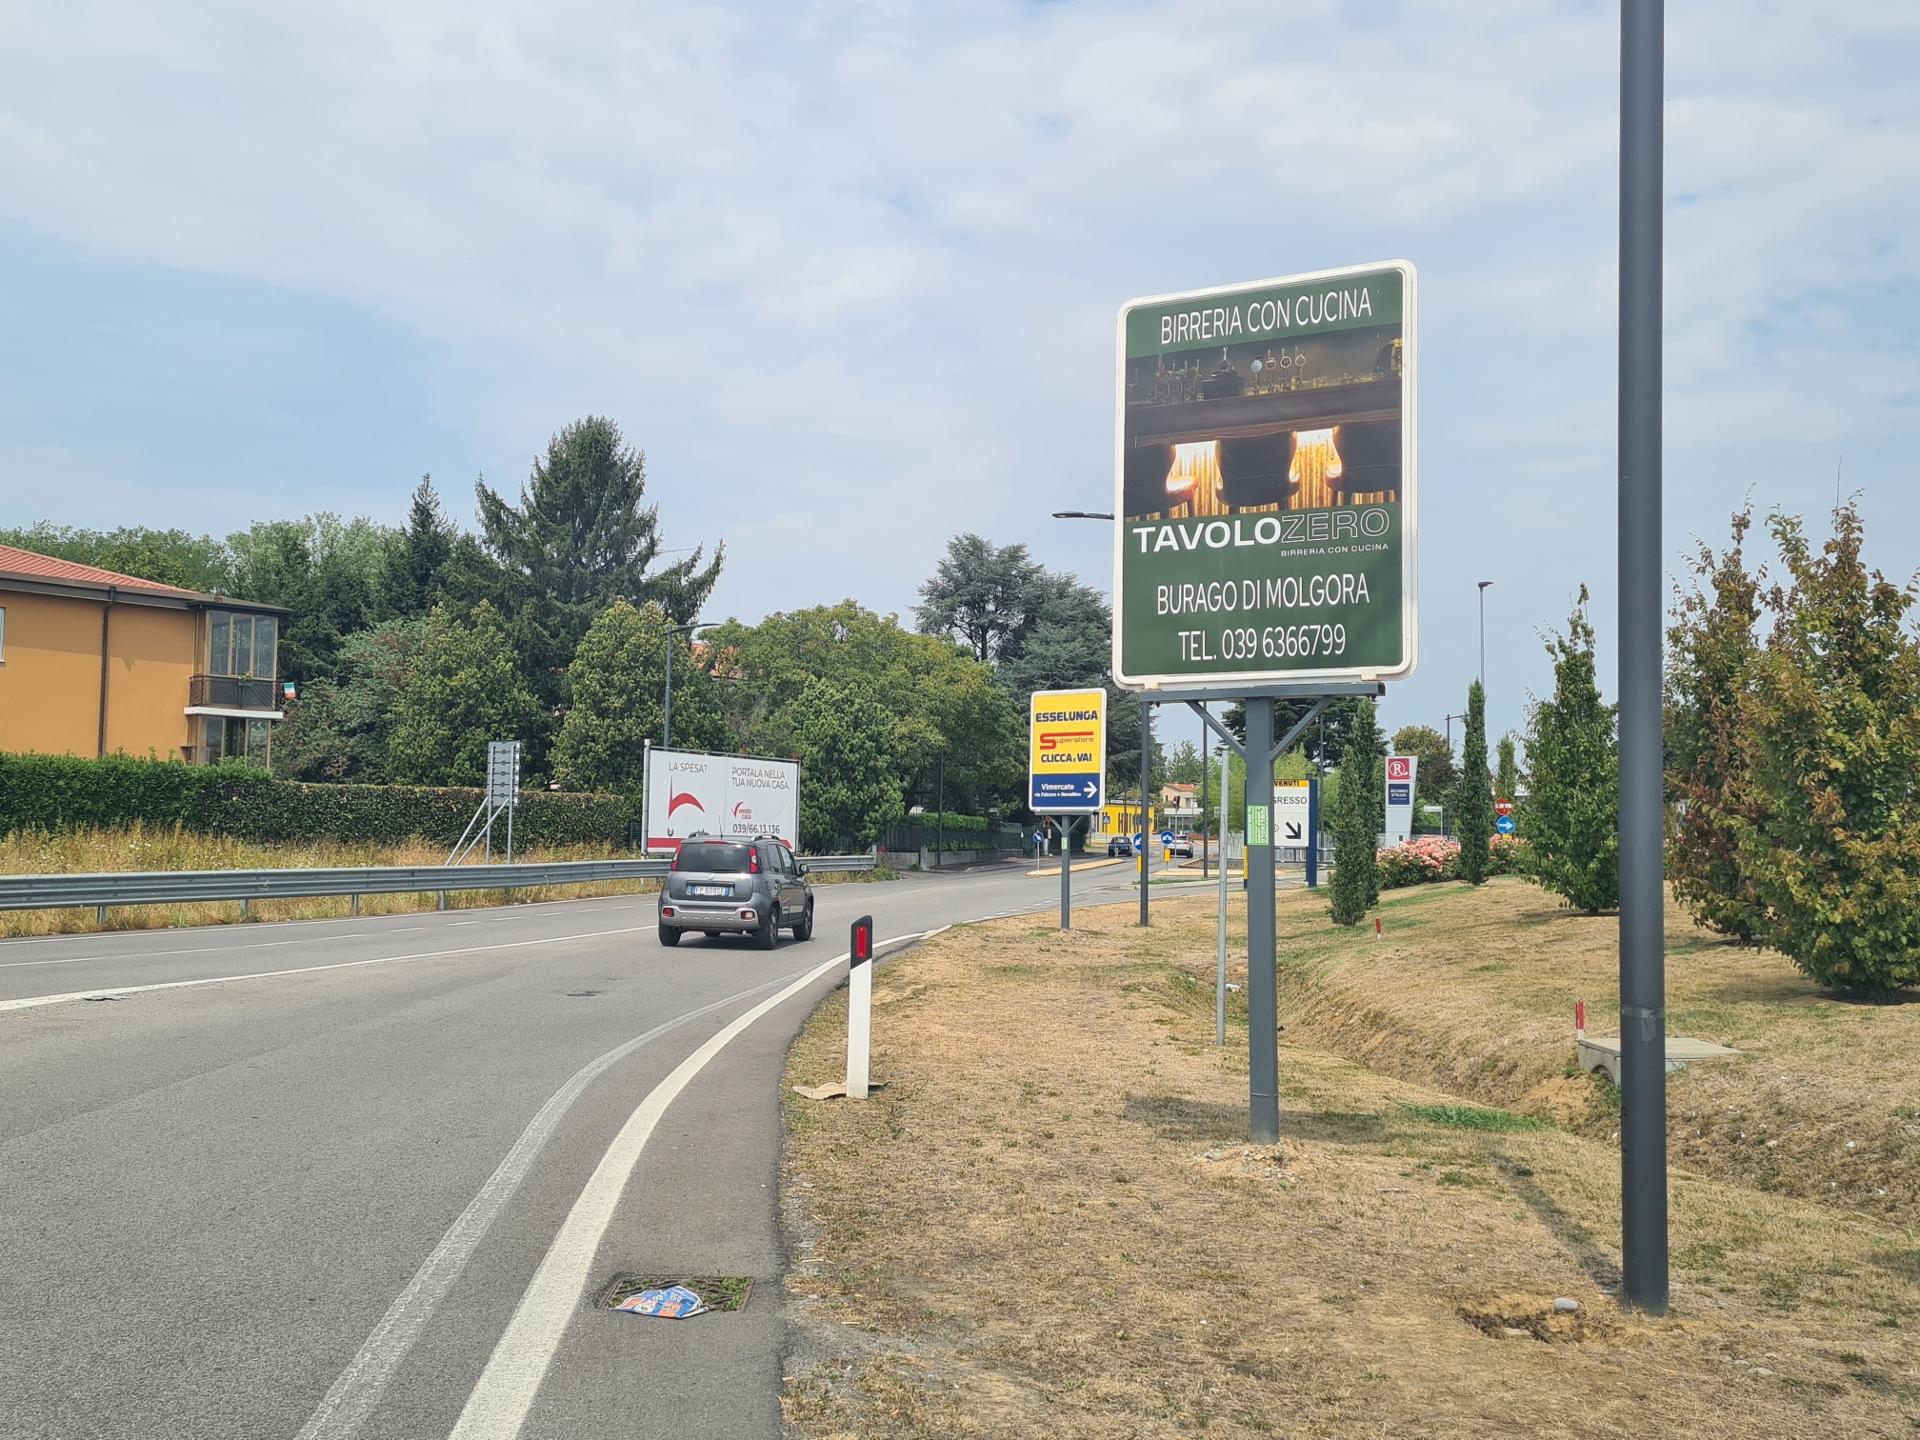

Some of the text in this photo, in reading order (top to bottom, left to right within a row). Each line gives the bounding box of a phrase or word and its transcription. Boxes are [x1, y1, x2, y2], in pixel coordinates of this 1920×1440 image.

[1161, 287, 1373, 345] BIRRERIA CON CUCINA
[1280, 543, 1389, 557] BIRRERIA CON CUCINA
[1157, 572, 1370, 615] BURAGO DI MOLGORA
[1178, 623, 1346, 661] TEL. 039 6366799
[1036, 711, 1098, 722] ESSELUNGA
[1041, 753, 1072, 763] CLICCA
[1077, 753, 1092, 762] VAI
[668, 762, 708, 774] LA SPESA?
[731, 767, 785, 780] PORTALA NELLA
[731, 777, 745, 788] TUA
[746, 778, 771, 789] NUOVA
[1041, 783, 1074, 791] Vimercate
[1274, 796, 1308, 805] RESSO
